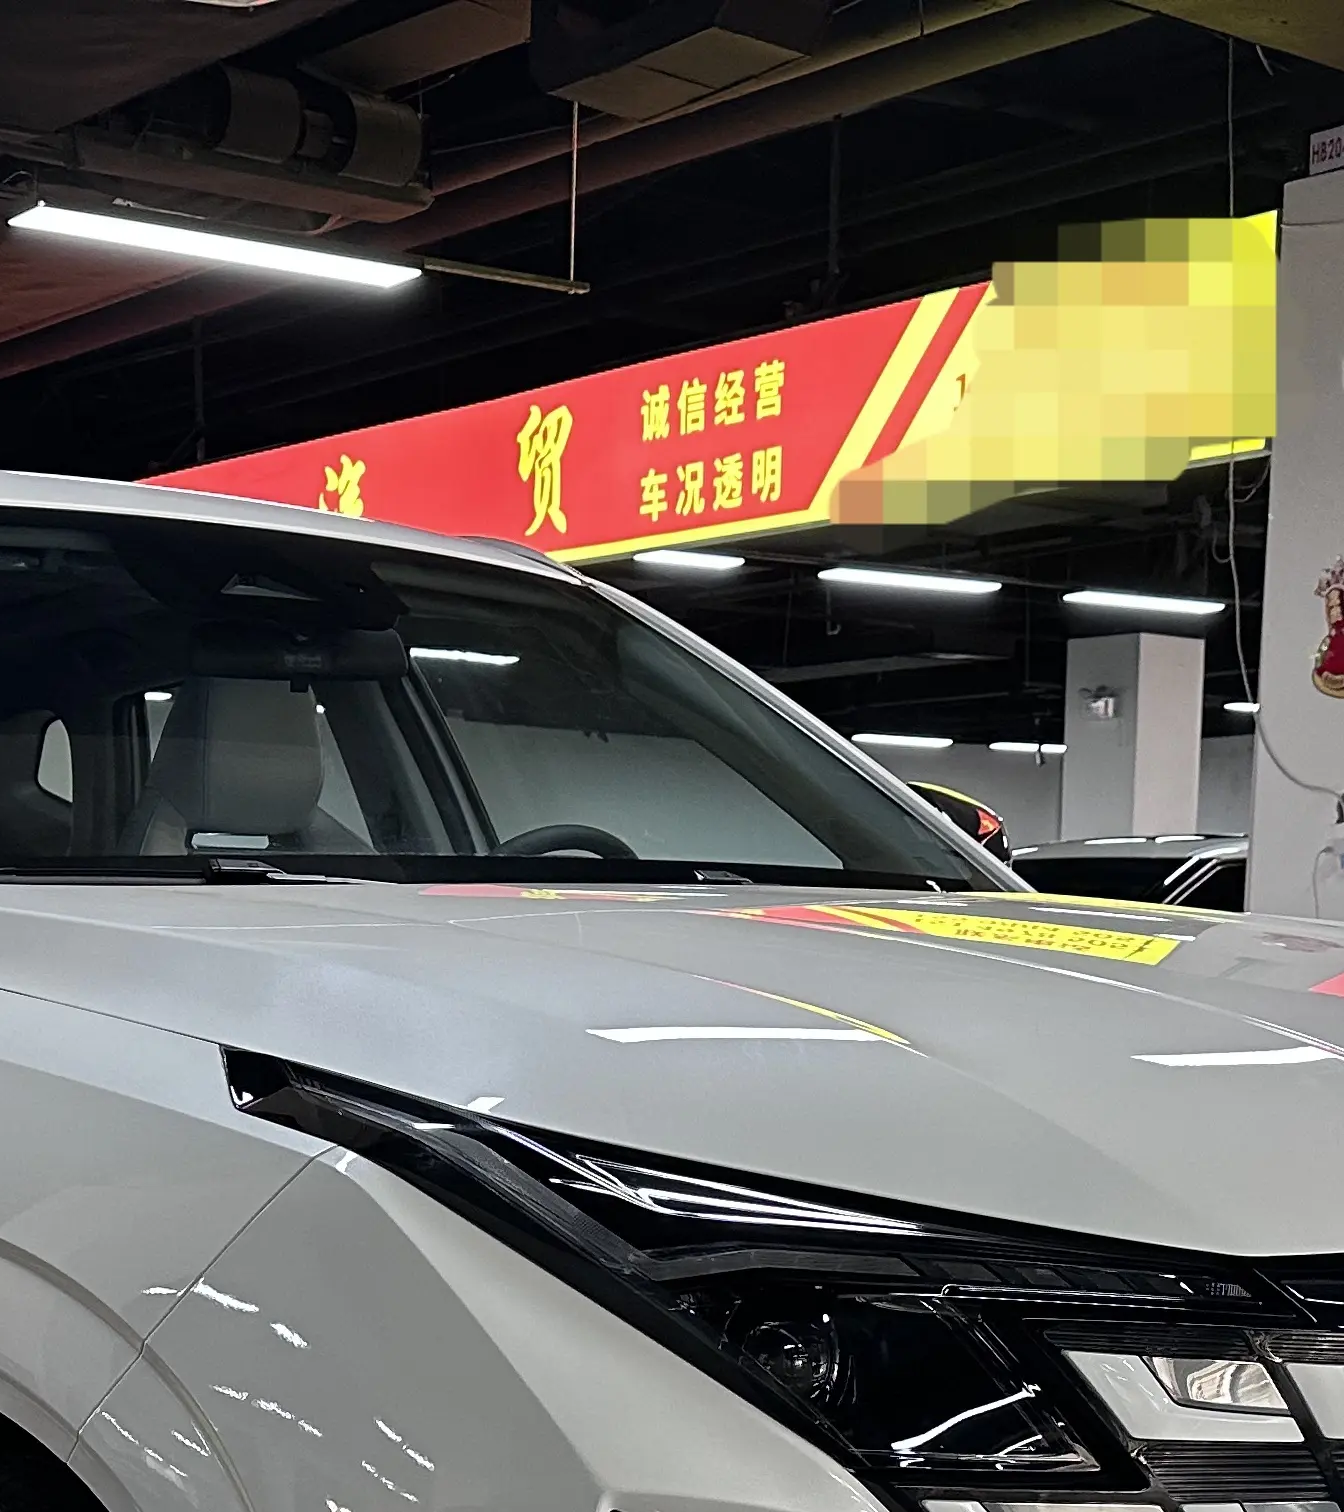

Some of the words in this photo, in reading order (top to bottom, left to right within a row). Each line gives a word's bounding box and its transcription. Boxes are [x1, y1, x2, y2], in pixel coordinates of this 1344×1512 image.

[640, 358, 786, 443] 诚信经营
[516, 403, 574, 537] 贸
[639, 445, 784, 523] 车况透明
